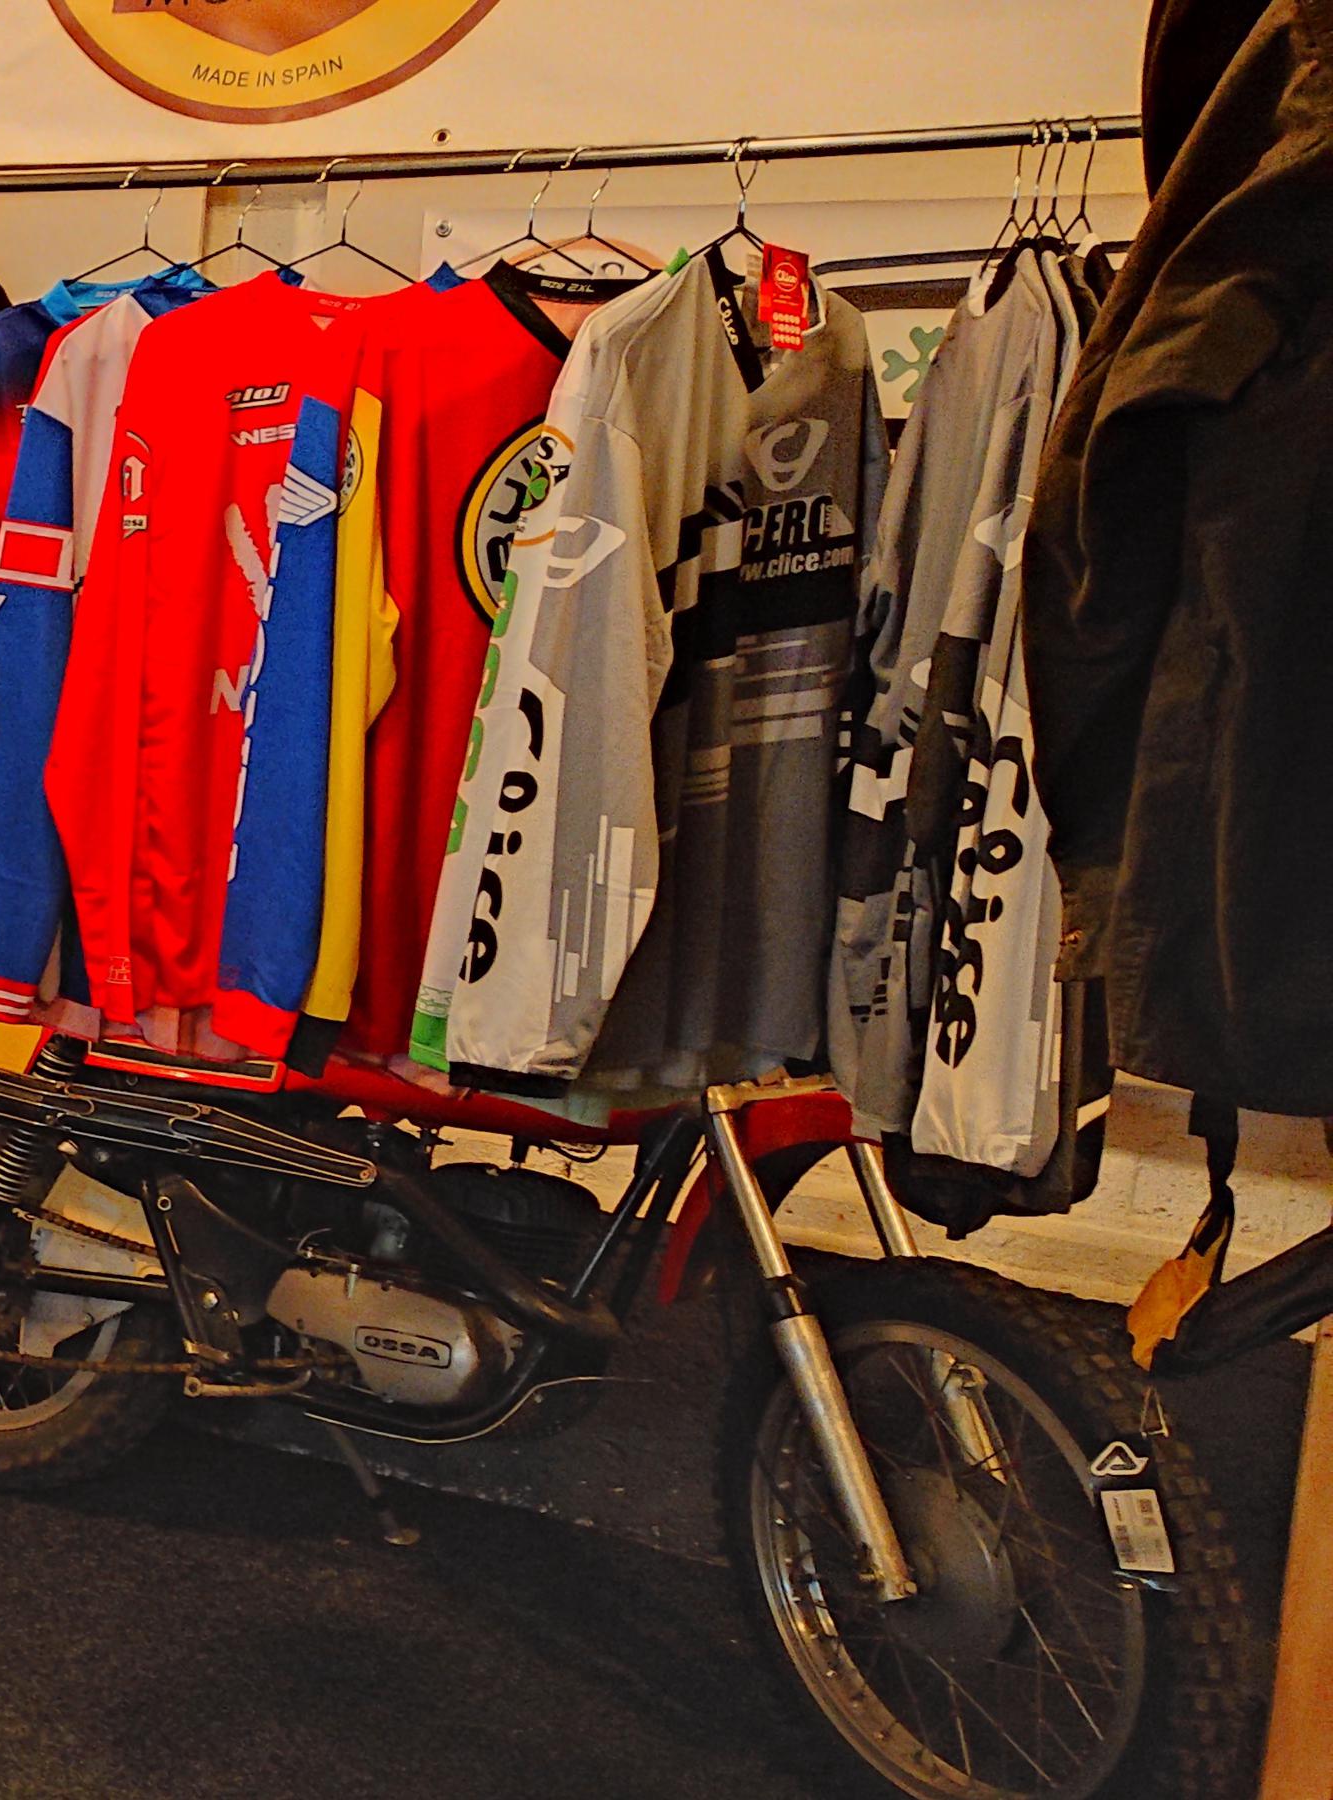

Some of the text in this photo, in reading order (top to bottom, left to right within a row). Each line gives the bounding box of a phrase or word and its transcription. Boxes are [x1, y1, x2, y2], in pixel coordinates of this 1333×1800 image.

[192, 55, 345, 88] MADE IN SPAIN
[363, 1335, 440, 1361] OSSA
